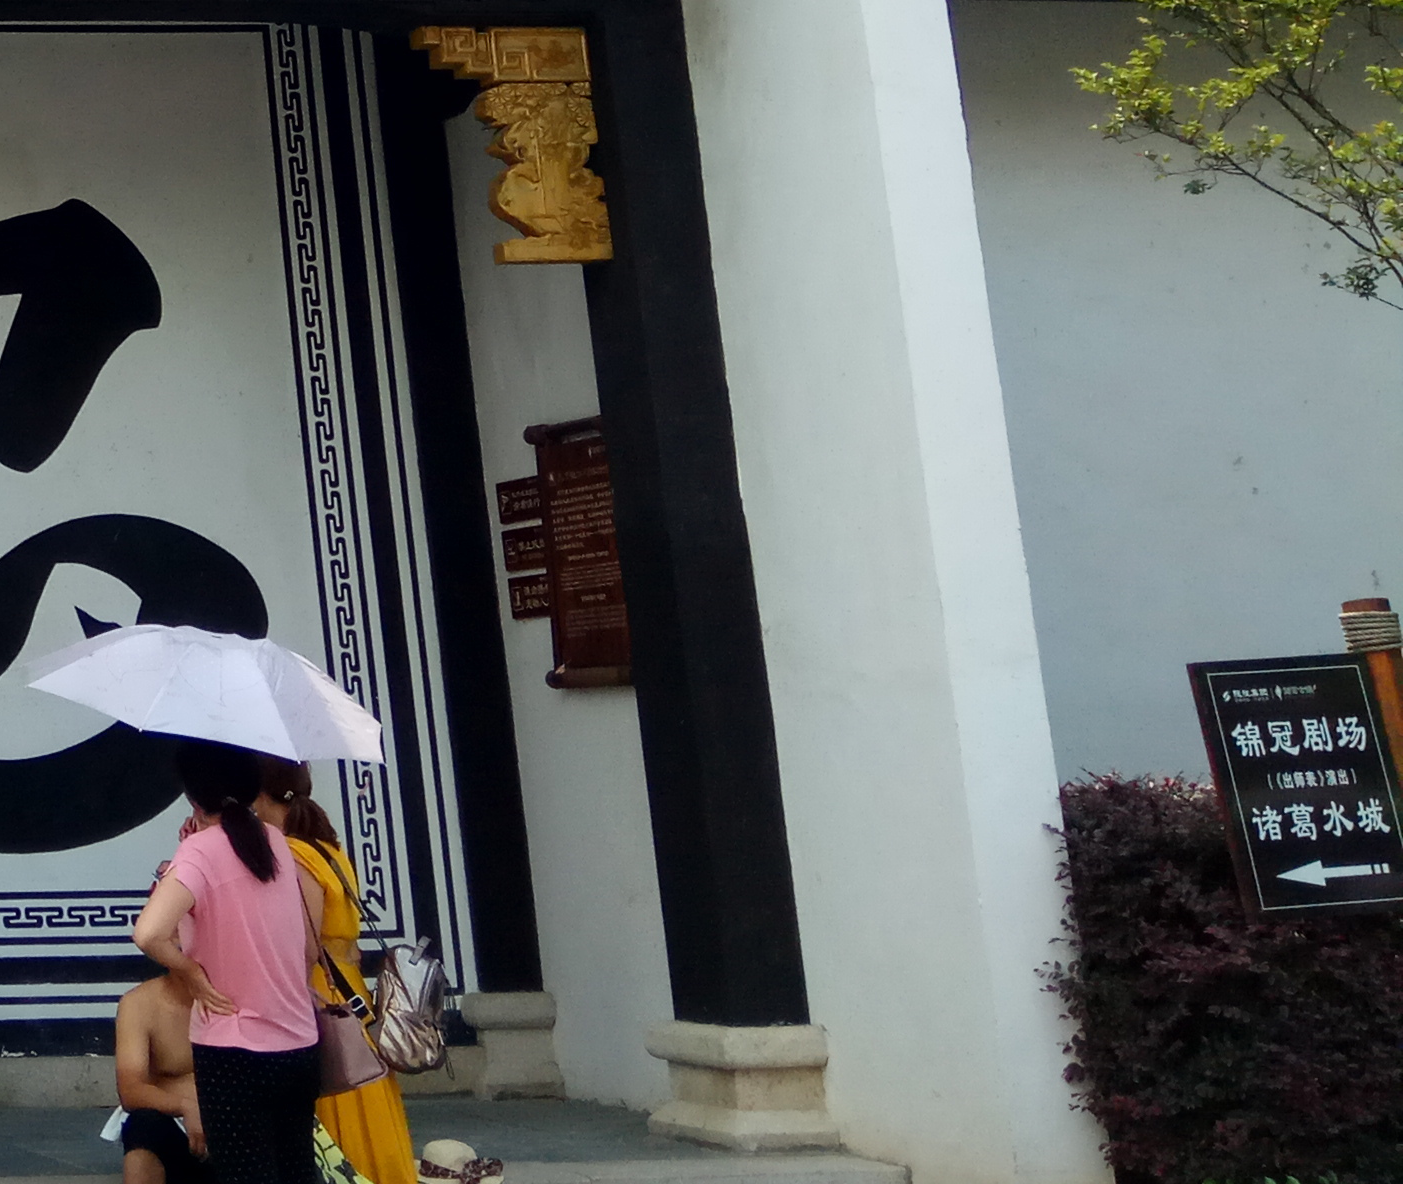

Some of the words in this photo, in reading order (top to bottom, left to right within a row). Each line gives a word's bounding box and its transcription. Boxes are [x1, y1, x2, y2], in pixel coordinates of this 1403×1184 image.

[1231, 715, 1368, 758] 锦冠剧场
[1251, 797, 1391, 842] 诸葛水城
